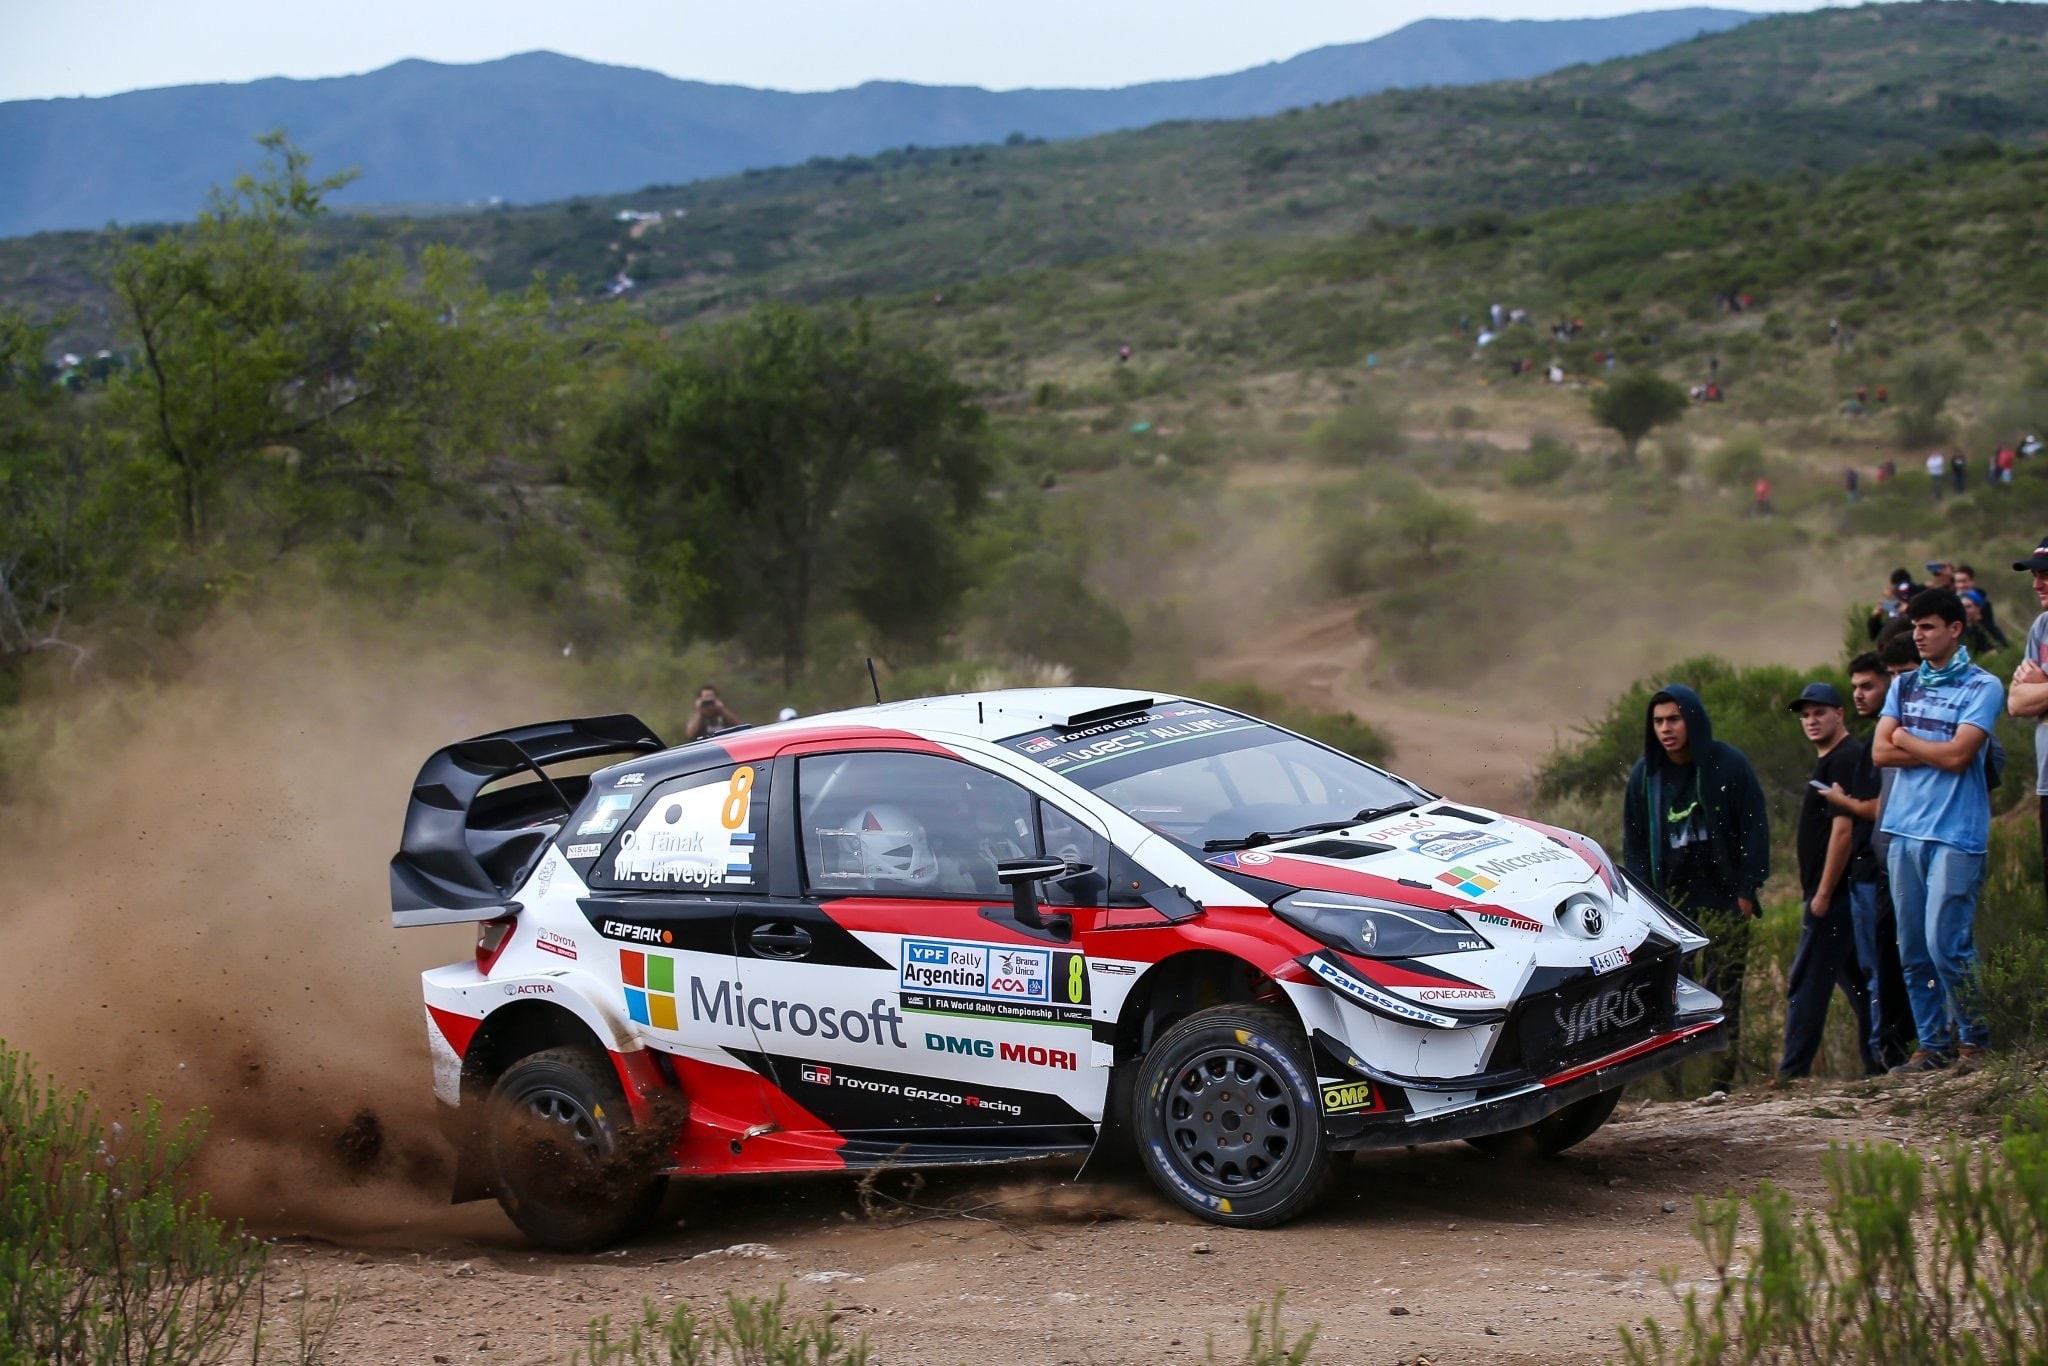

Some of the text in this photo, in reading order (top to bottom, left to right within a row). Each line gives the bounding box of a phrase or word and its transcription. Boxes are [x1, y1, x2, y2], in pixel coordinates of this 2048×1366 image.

[1053, 724, 1116, 743] TOYOTA
[1113, 713, 1164, 727] GAZOO
[1162, 708, 1210, 718] Racing
[1150, 725, 1190, 739] ALL
[1180, 719, 1226, 732] LIVE
[722, 766, 753, 829] 8
[1366, 820, 1436, 840] DENSO
[568, 845, 600, 855] NISULA
[620, 829, 705, 853] O. Tänak
[1475, 846, 1573, 877] Microsoft
[614, 860, 722, 888] M. Järveoja
[1479, 913, 1544, 933] DMG MORI
[549, 932, 577, 949] TOYOTA
[1457, 941, 1487, 950] PIAA
[912, 947, 981, 968] YPF Rally
[1015, 957, 1039, 967] Branca
[904, 963, 985, 987] Argentina
[991, 978, 1025, 993] ACA
[1068, 954, 1084, 1003] 8
[518, 984, 555, 994] ACTRA
[1318, 963, 1447, 1025] Panasonic
[1419, 990, 1496, 1001] KONECRANES
[690, 976, 907, 1048] Microsoft
[936, 999, 949, 1009] FIA
[951, 1001, 974, 1011] World
[975, 1004, 996, 1014] Rally
[997, 1005, 1053, 1019] Championship
[925, 1033, 1077, 1071] DMG MORI
[804, 1070, 1022, 1116] GR TOYOTA GAZOO Racing
[1324, 1086, 1369, 1108] OMP
